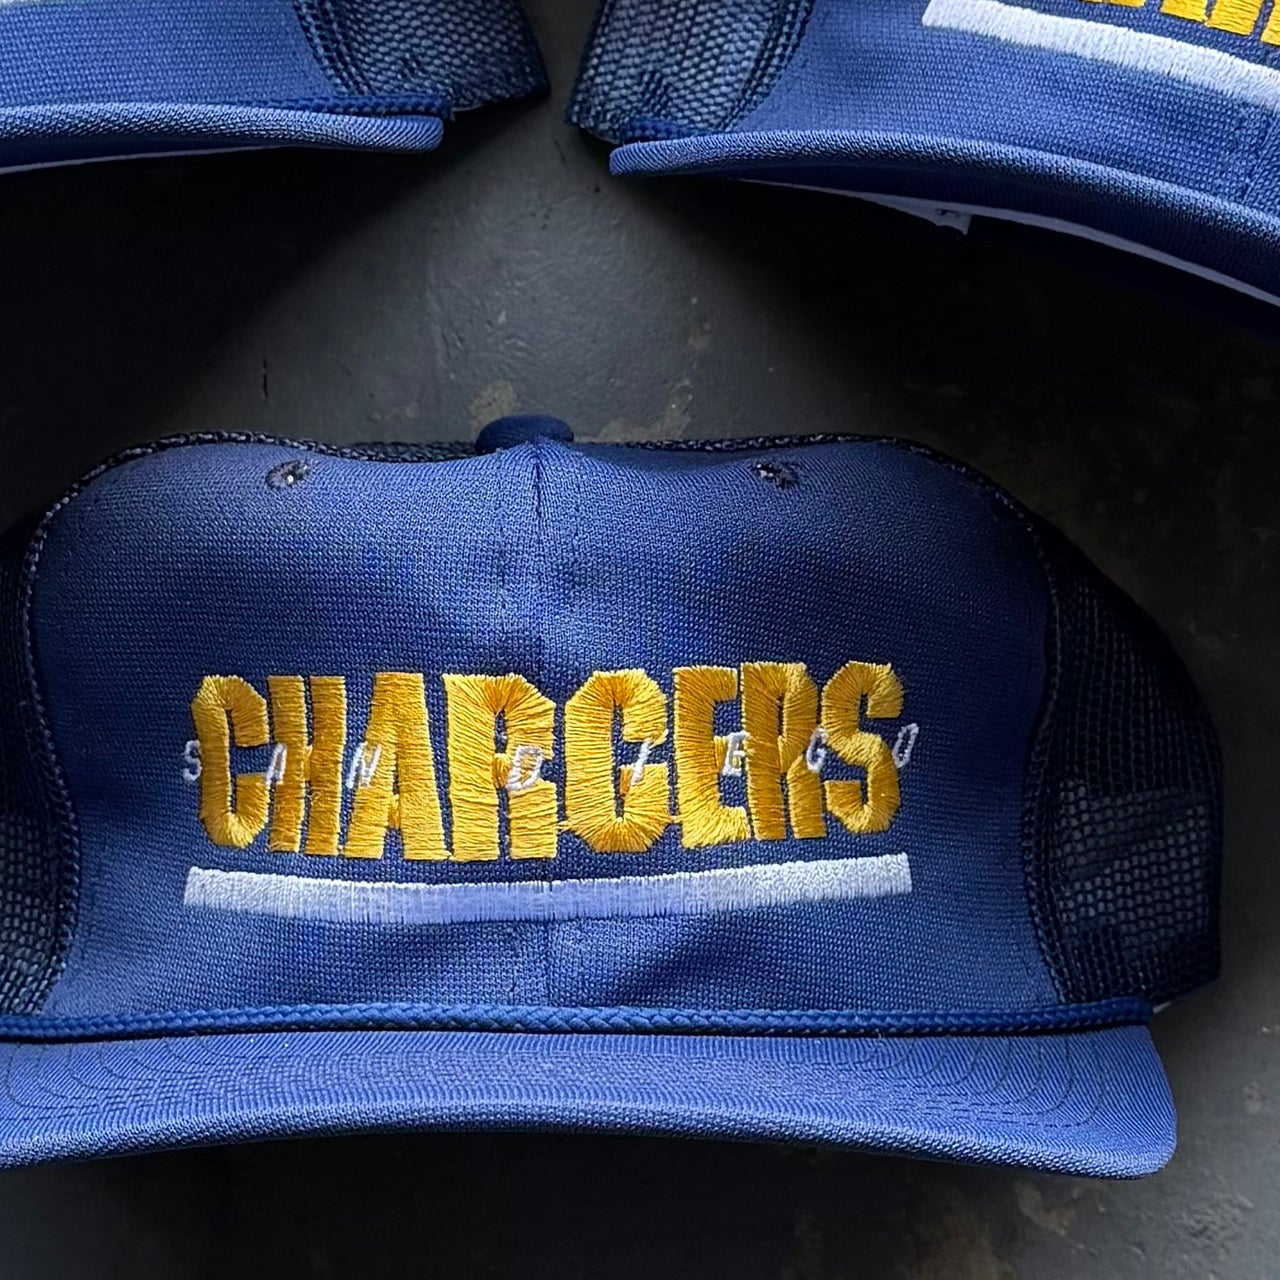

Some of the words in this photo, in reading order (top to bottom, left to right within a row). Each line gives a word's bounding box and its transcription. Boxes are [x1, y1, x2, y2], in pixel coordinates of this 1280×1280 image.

[182, 740, 381, 790] SAN
[509, 722, 917, 792] DIEGO
[190, 661, 906, 861] CHARGERS
